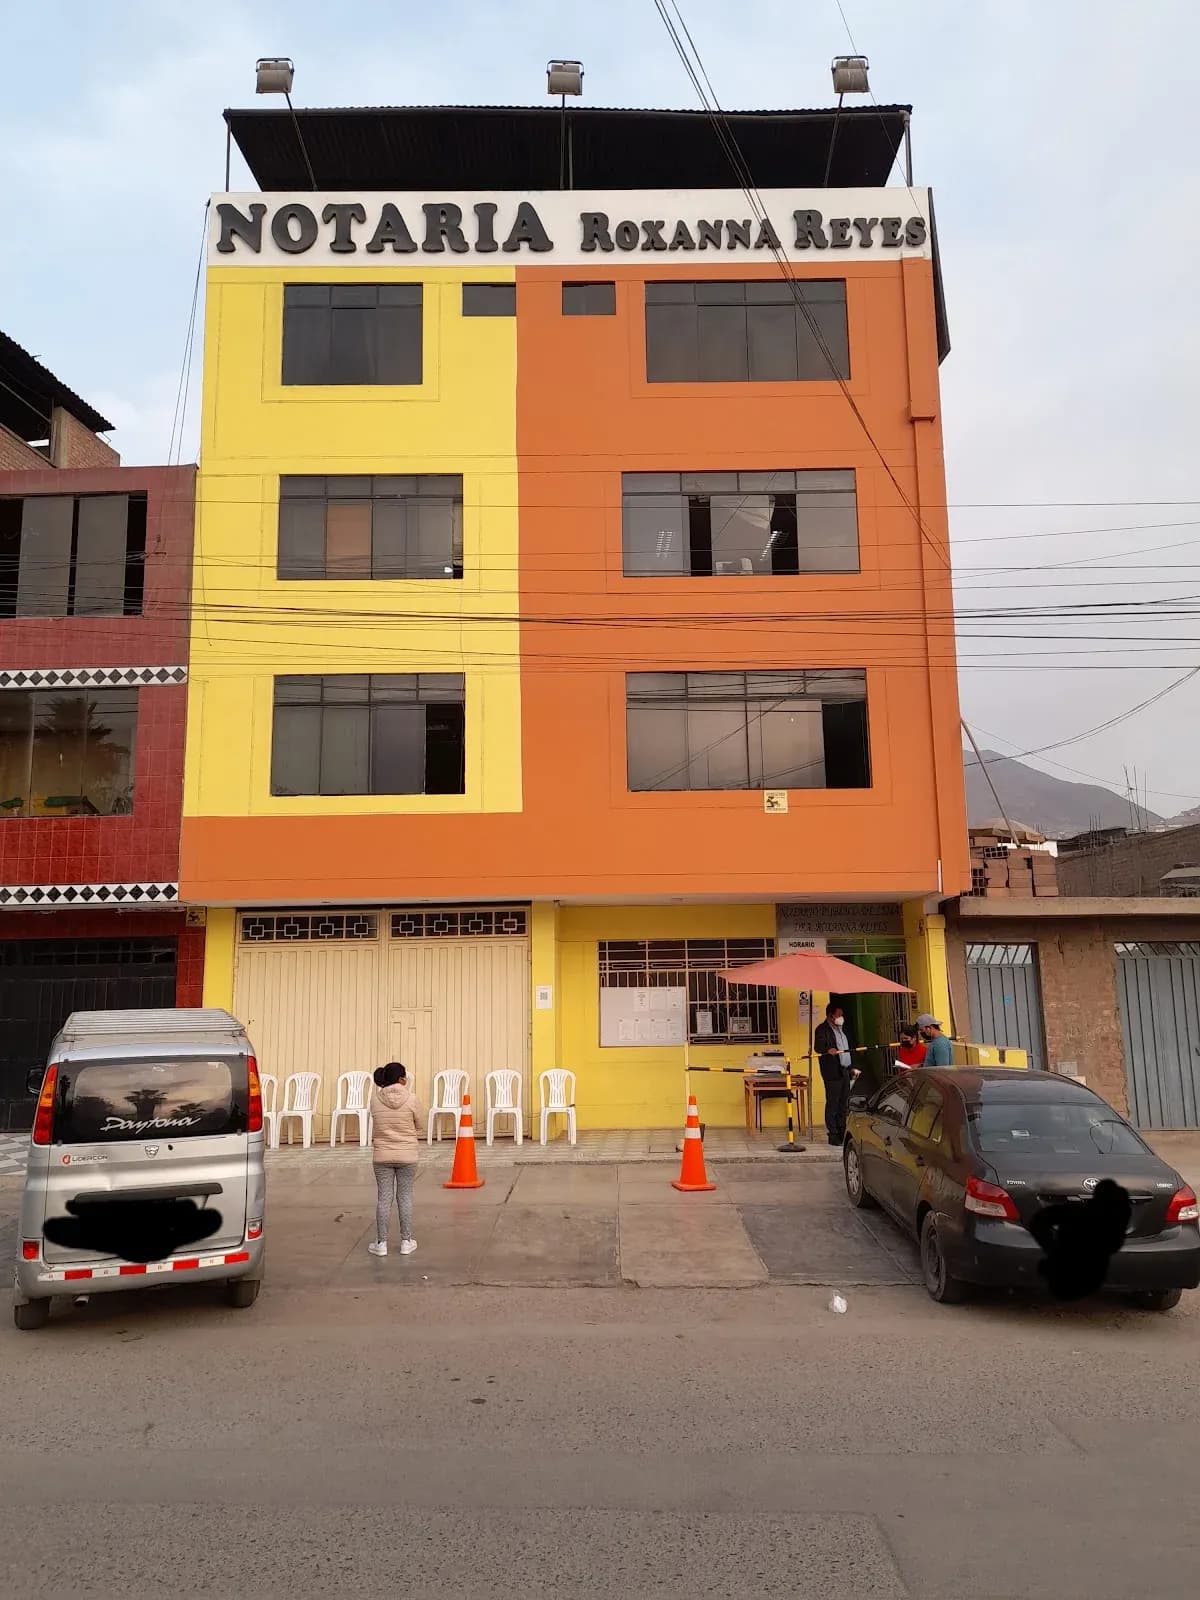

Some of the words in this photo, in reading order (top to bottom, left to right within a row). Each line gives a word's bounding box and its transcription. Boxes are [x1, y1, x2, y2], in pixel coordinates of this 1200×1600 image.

[215, 201, 554, 254] NOTARIA
[580, 211, 782, 251] ROXANNA
[793, 209, 927, 249] REYES
[100, 1116, 201, 1134] Daytona
